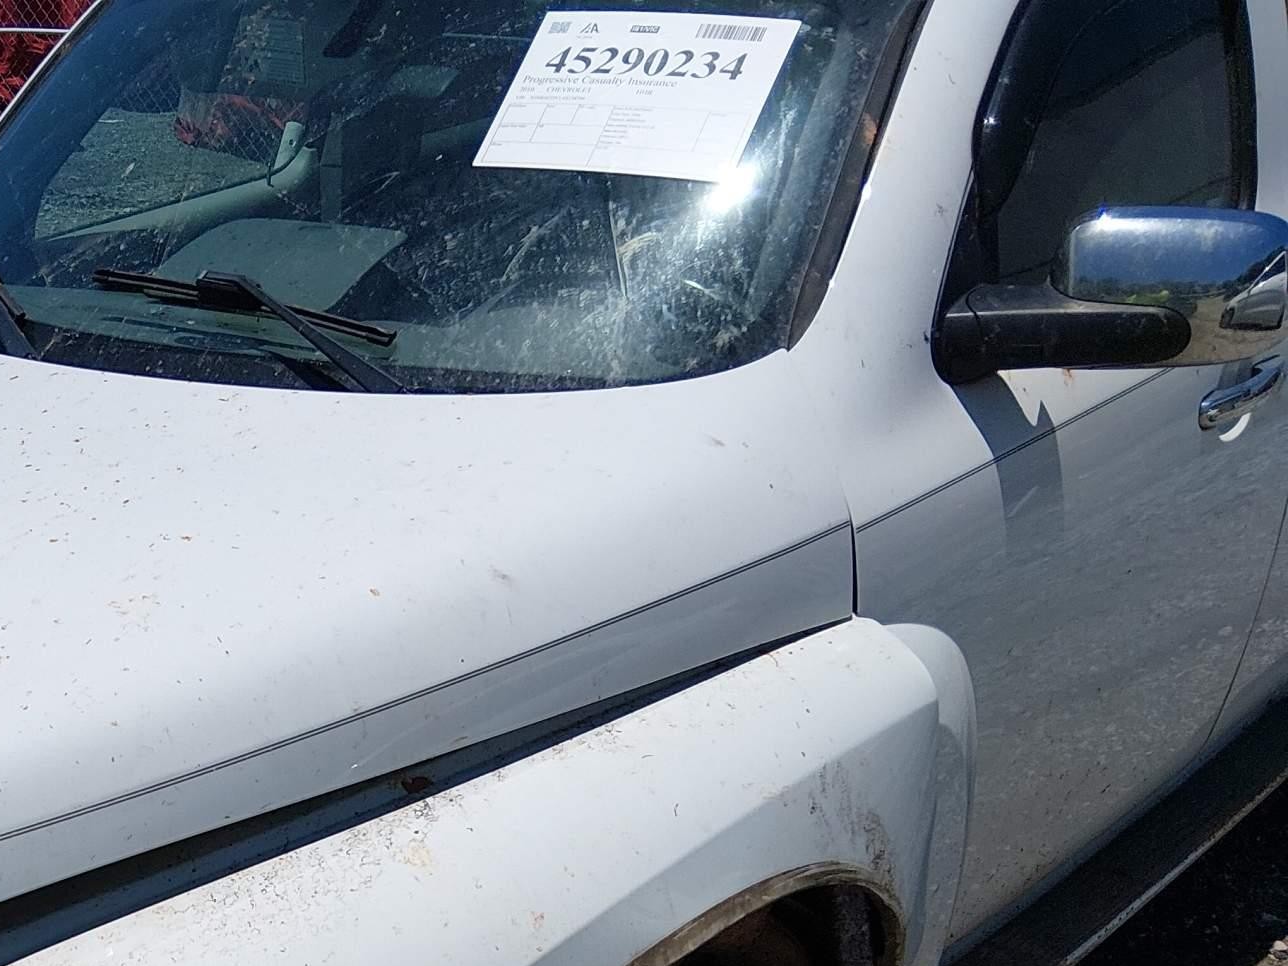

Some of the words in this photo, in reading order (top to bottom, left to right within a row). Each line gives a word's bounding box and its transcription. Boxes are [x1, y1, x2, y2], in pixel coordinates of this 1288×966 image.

[545, 46, 749, 81] 45290234
[522, 74, 579, 87] Progressive
[581, 77, 624, 88] Casualty
[628, 77, 678, 88] Insurance
